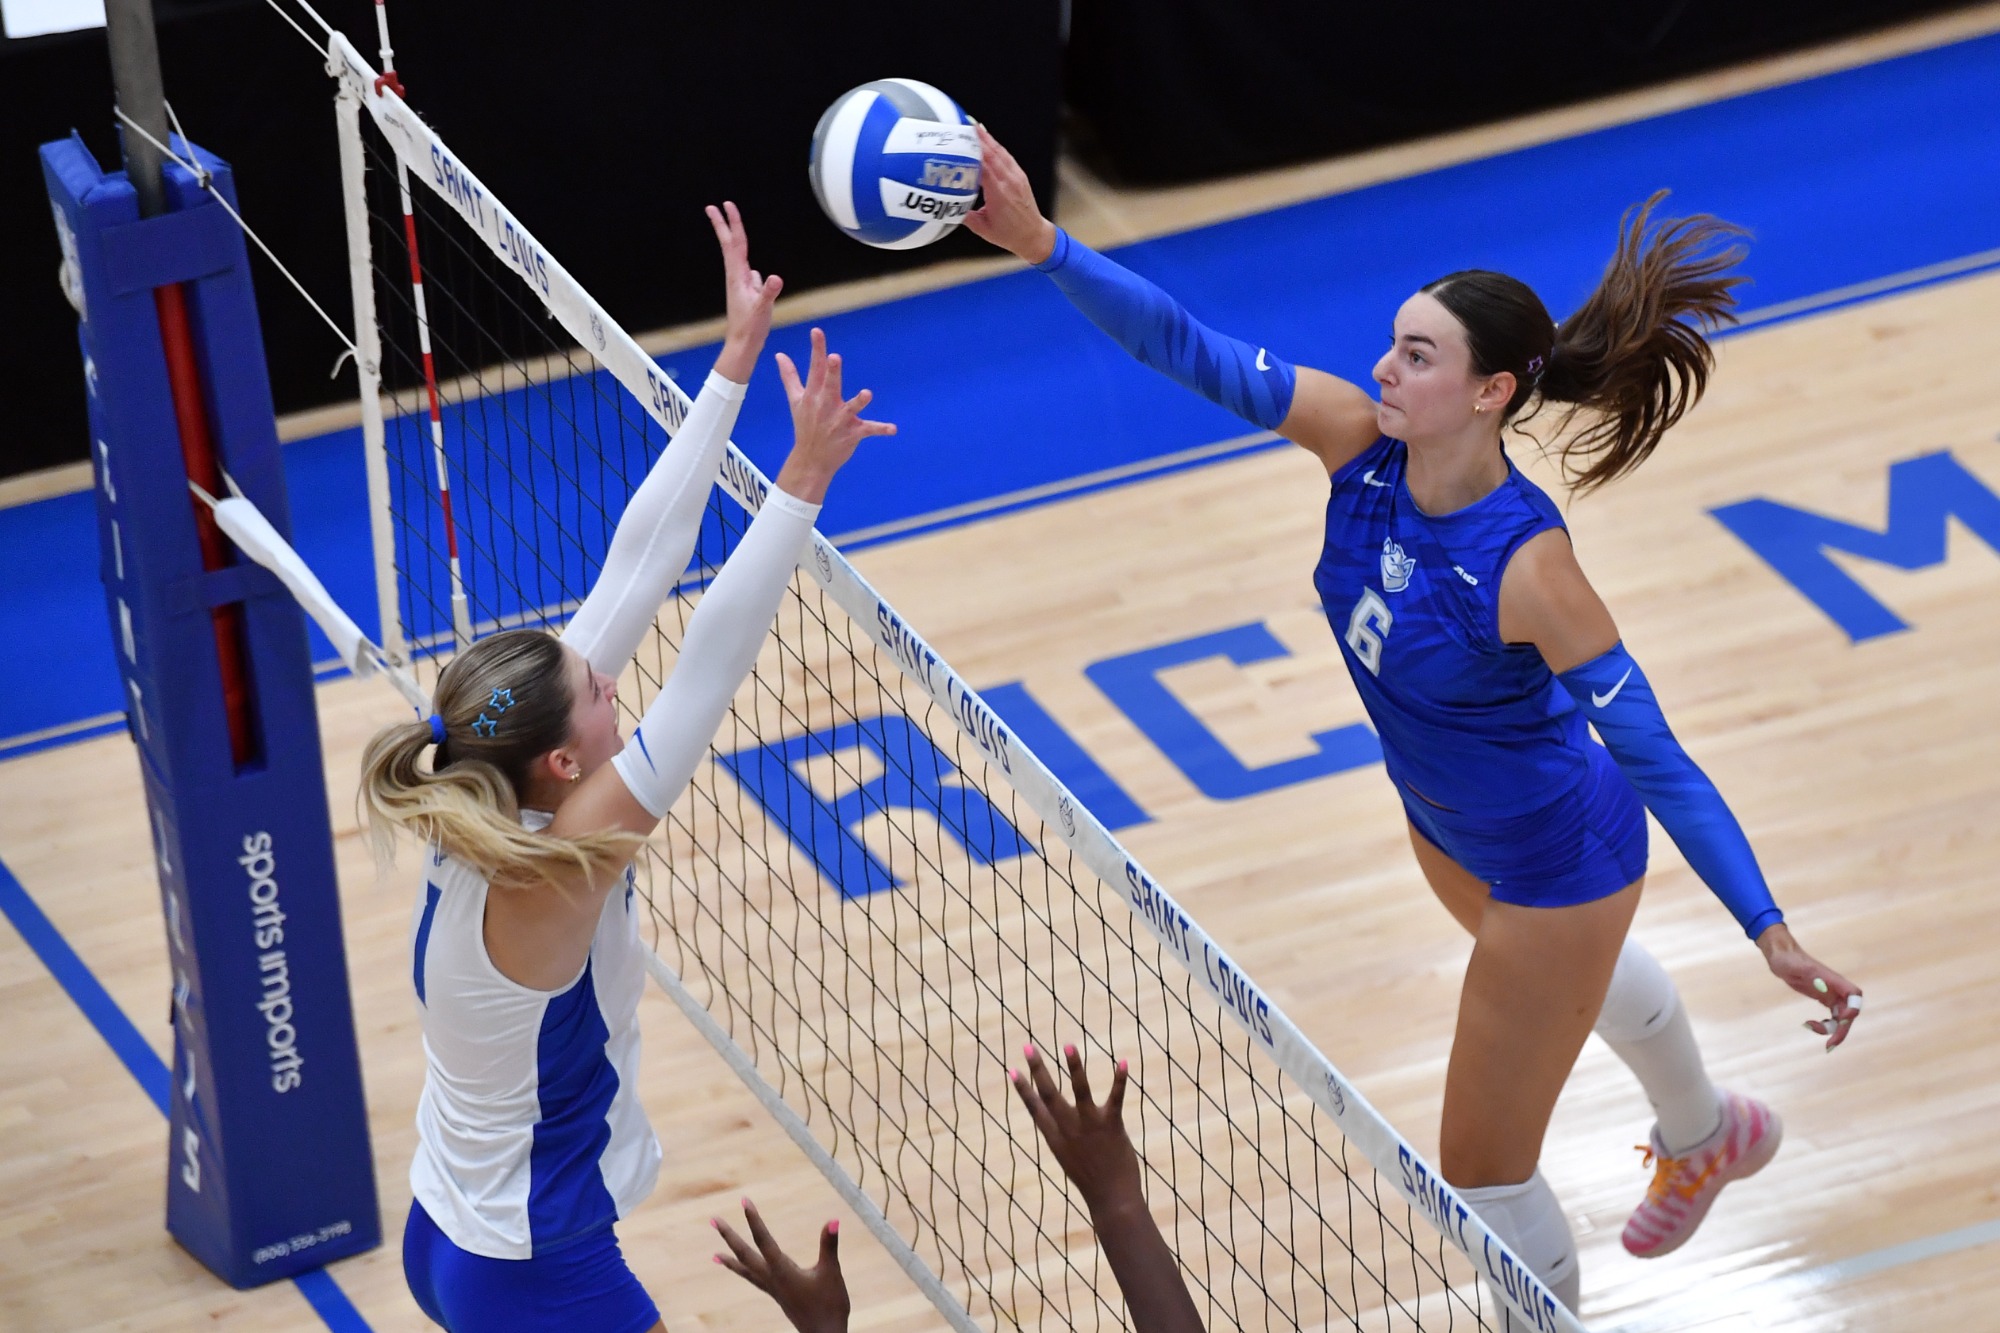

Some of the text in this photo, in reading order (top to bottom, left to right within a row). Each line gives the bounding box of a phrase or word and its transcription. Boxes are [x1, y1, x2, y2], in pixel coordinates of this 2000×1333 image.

[431, 143, 549, 297] SAINT LOUIS
[647, 367, 689, 428] SAIN
[877, 601, 1011, 775] SAINT LOUIS
[1344, 585, 1393, 678] 6
[237, 830, 305, 1094] sports imports
[1125, 860, 1274, 1049] SAINT LOUIS
[1398, 1143, 1557, 1333] SAINT LOUIS
